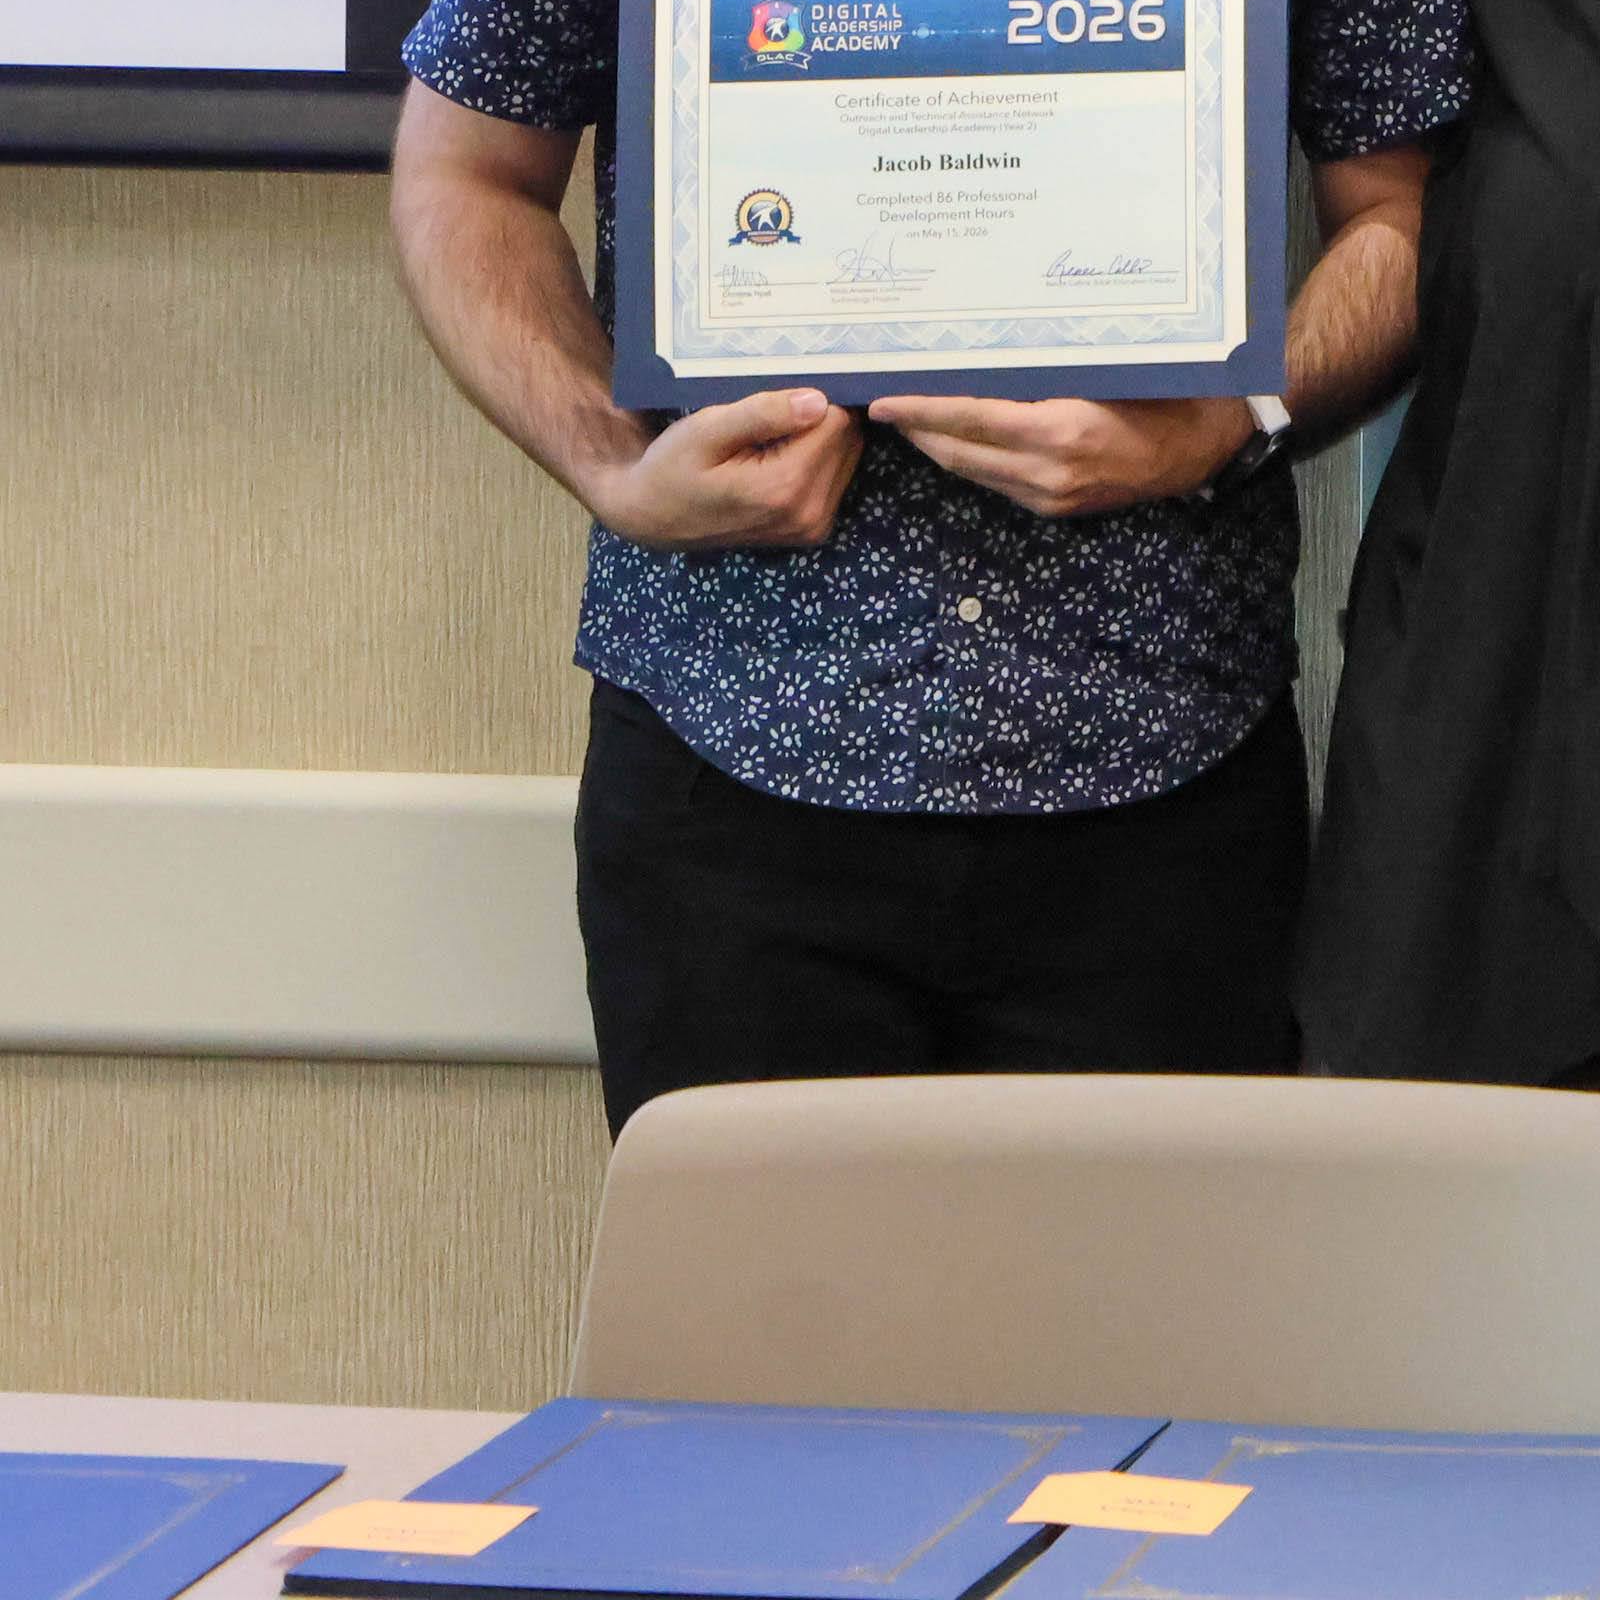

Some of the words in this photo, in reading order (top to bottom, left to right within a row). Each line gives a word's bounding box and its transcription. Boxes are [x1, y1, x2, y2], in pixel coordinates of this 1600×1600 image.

[812, 3, 902, 20] DIGITAL
[812, 20, 903, 33] LEADERSHIP
[811, 35, 902, 52] ACADEMY
[756, 53, 795, 62] DLAC
[835, 92, 921, 109] Certificate
[926, 91, 943, 106] of
[948, 91, 1059, 105] Achievement
[889, 113, 908, 121] and
[1013, 109, 1054, 118] Network
[858, 126, 890, 137] Digital
[893, 125, 949, 135] Leadership
[951, 124, 996, 134] Academy
[873, 155, 931, 172] Jacob
[940, 152, 1021, 171] Baldwin
[856, 192, 932, 207] Completed
[937, 192, 953, 203] 86
[958, 189, 1037, 201] Professional
[879, 210, 971, 223] Development
[975, 208, 1015, 219] Hours
[906, 230, 920, 238] on
[922, 229, 942, 239] May
[964, 228, 988, 237] 2026
